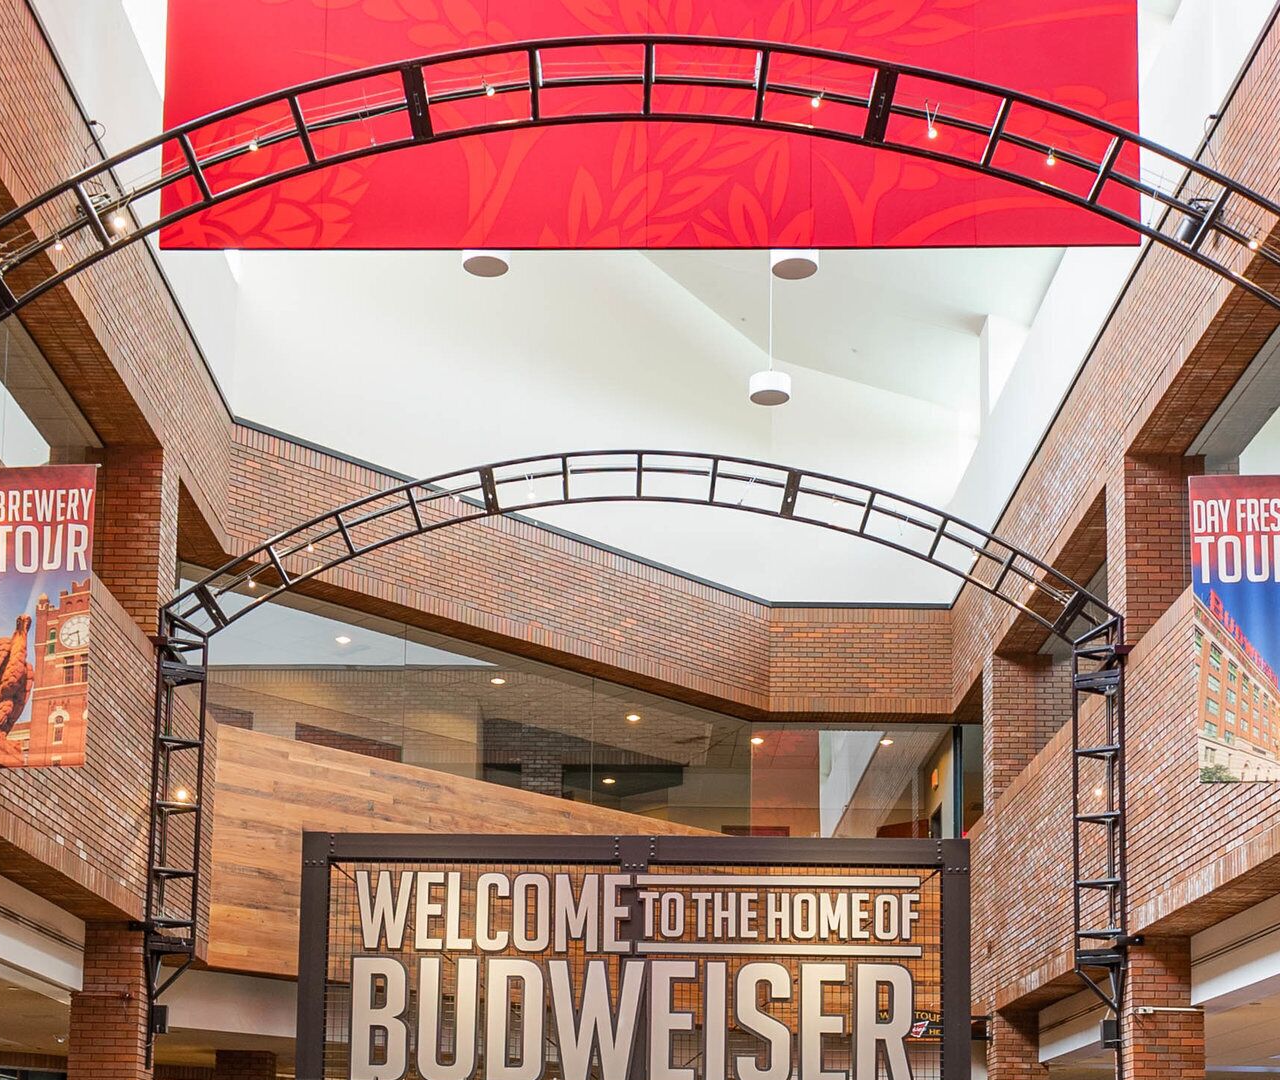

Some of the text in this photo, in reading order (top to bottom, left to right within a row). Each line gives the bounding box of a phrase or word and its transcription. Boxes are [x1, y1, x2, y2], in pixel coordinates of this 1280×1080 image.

[1193, 499, 1234, 534] DAY
[354, 871, 920, 953] WELCOME TO THE HOME OF
